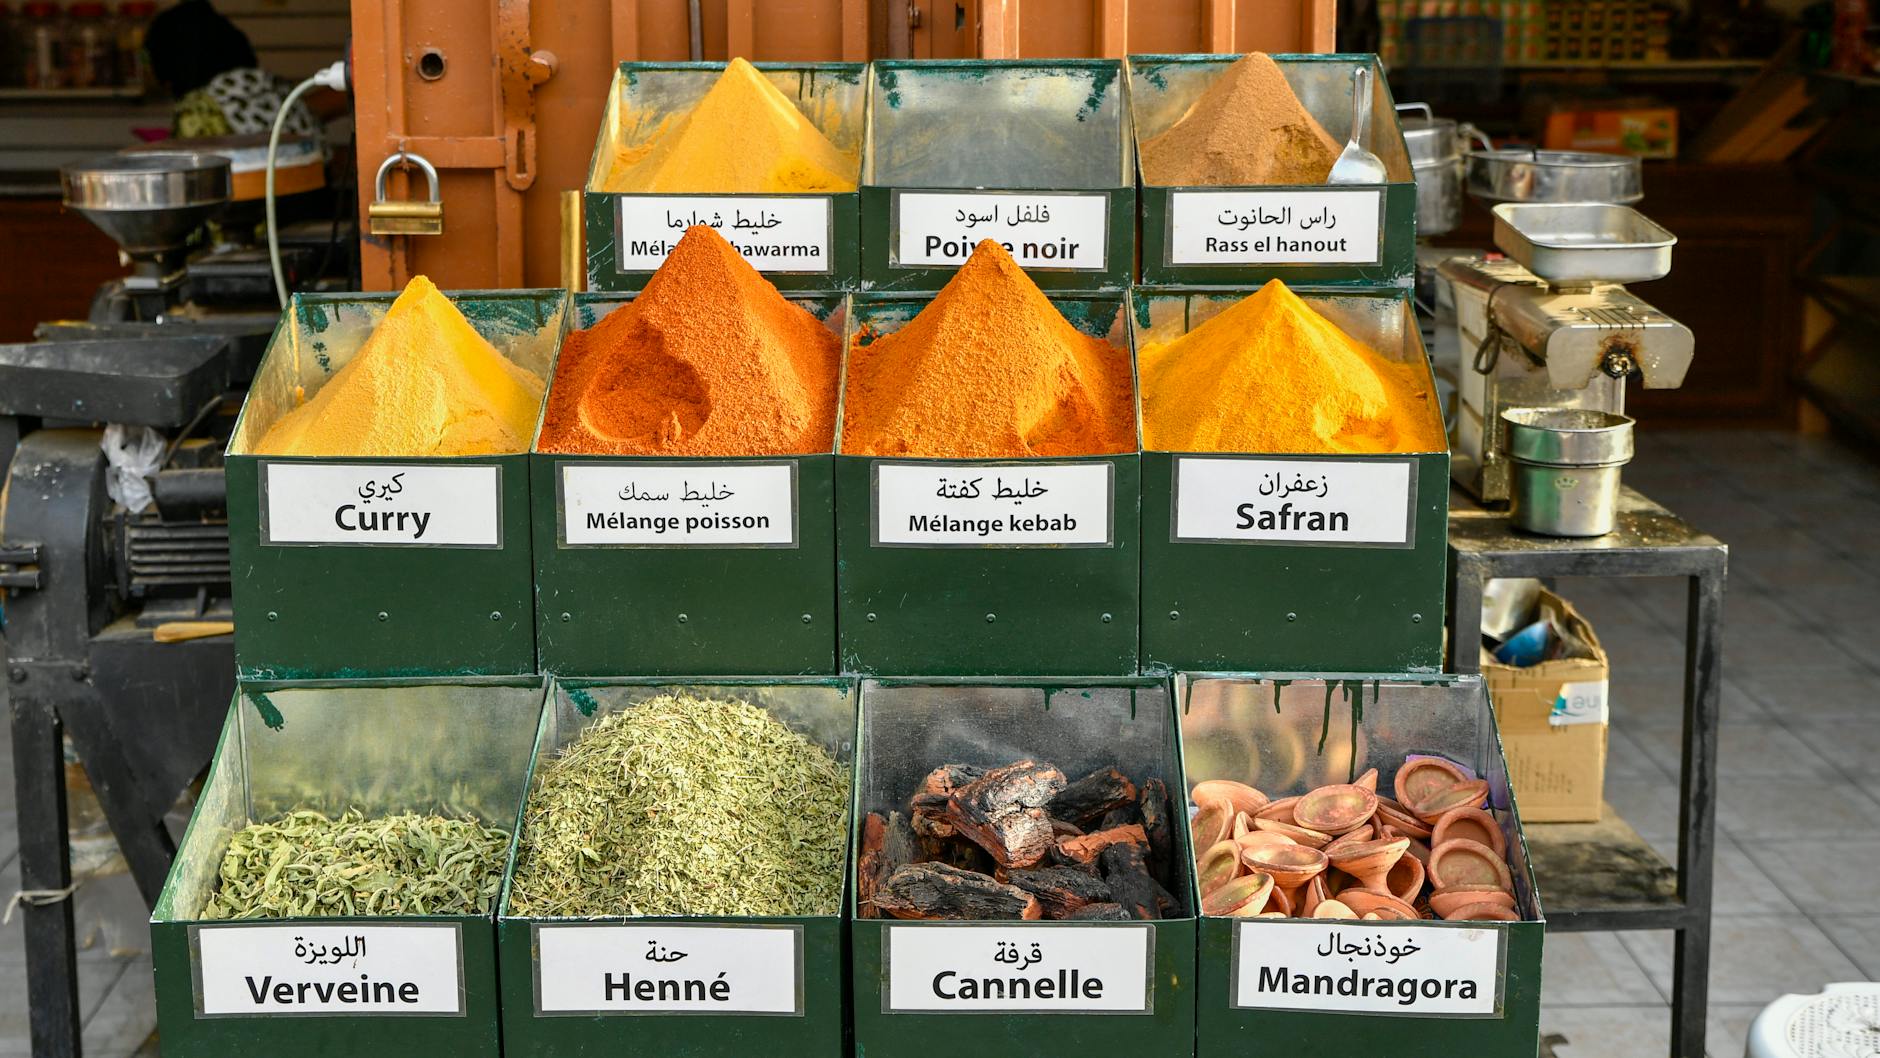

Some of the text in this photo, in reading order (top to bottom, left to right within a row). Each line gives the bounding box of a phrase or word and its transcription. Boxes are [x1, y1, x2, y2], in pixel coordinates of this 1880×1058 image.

[731, 209, 782, 236] خليط
[955, 204, 1050, 229] فلفل اسود
[1217, 206, 1336, 232] راس الحانوت
[631, 240, 820, 257] Méla hawarma
[925, 235, 1080, 260] Poie noir
[1205, 236, 1347, 253] Rass el hanout
[358, 472, 406, 504] كيري
[618, 480, 735, 508] خليط سمك
[936, 476, 1049, 506] خليط كفتة
[1258, 471, 1328, 499] زعفران
[334, 504, 432, 539] Curry
[586, 511, 770, 534] Mélange poisson
[908, 513, 1077, 537] Mélange kebab
[1235, 502, 1349, 532] Safran
[294, 935, 366, 965] اللويزة
[645, 940, 689, 963] حنة
[993, 940, 1043, 971] قرفة
[1317, 931, 1422, 964] خوذنجال
[244, 973, 420, 1005] Verveine
[604, 971, 731, 1002] Henné
[932, 968, 1104, 1000] Cannelle
[1257, 966, 1478, 1006] Mandragora
